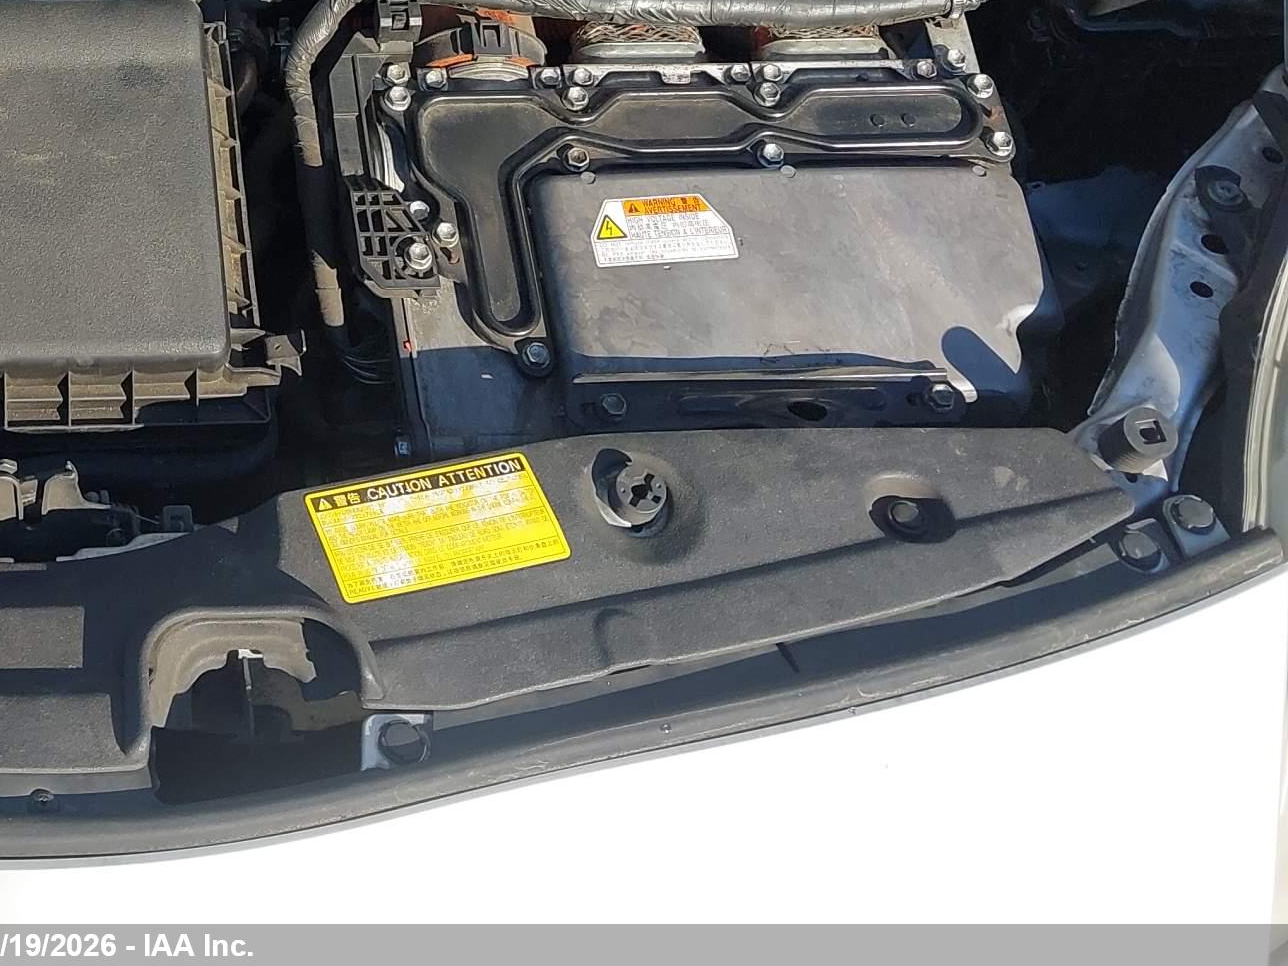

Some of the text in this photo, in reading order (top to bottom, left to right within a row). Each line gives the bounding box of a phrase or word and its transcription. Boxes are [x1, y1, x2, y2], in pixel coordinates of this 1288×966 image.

[642, 197, 676, 207] WARNING
[644, 203, 701, 215] AVERTISSEMENT
[647, 215, 676, 224] VOLTAGE
[367, 477, 433, 501] CAUTION
[438, 458, 522, 487] ATTENTION
